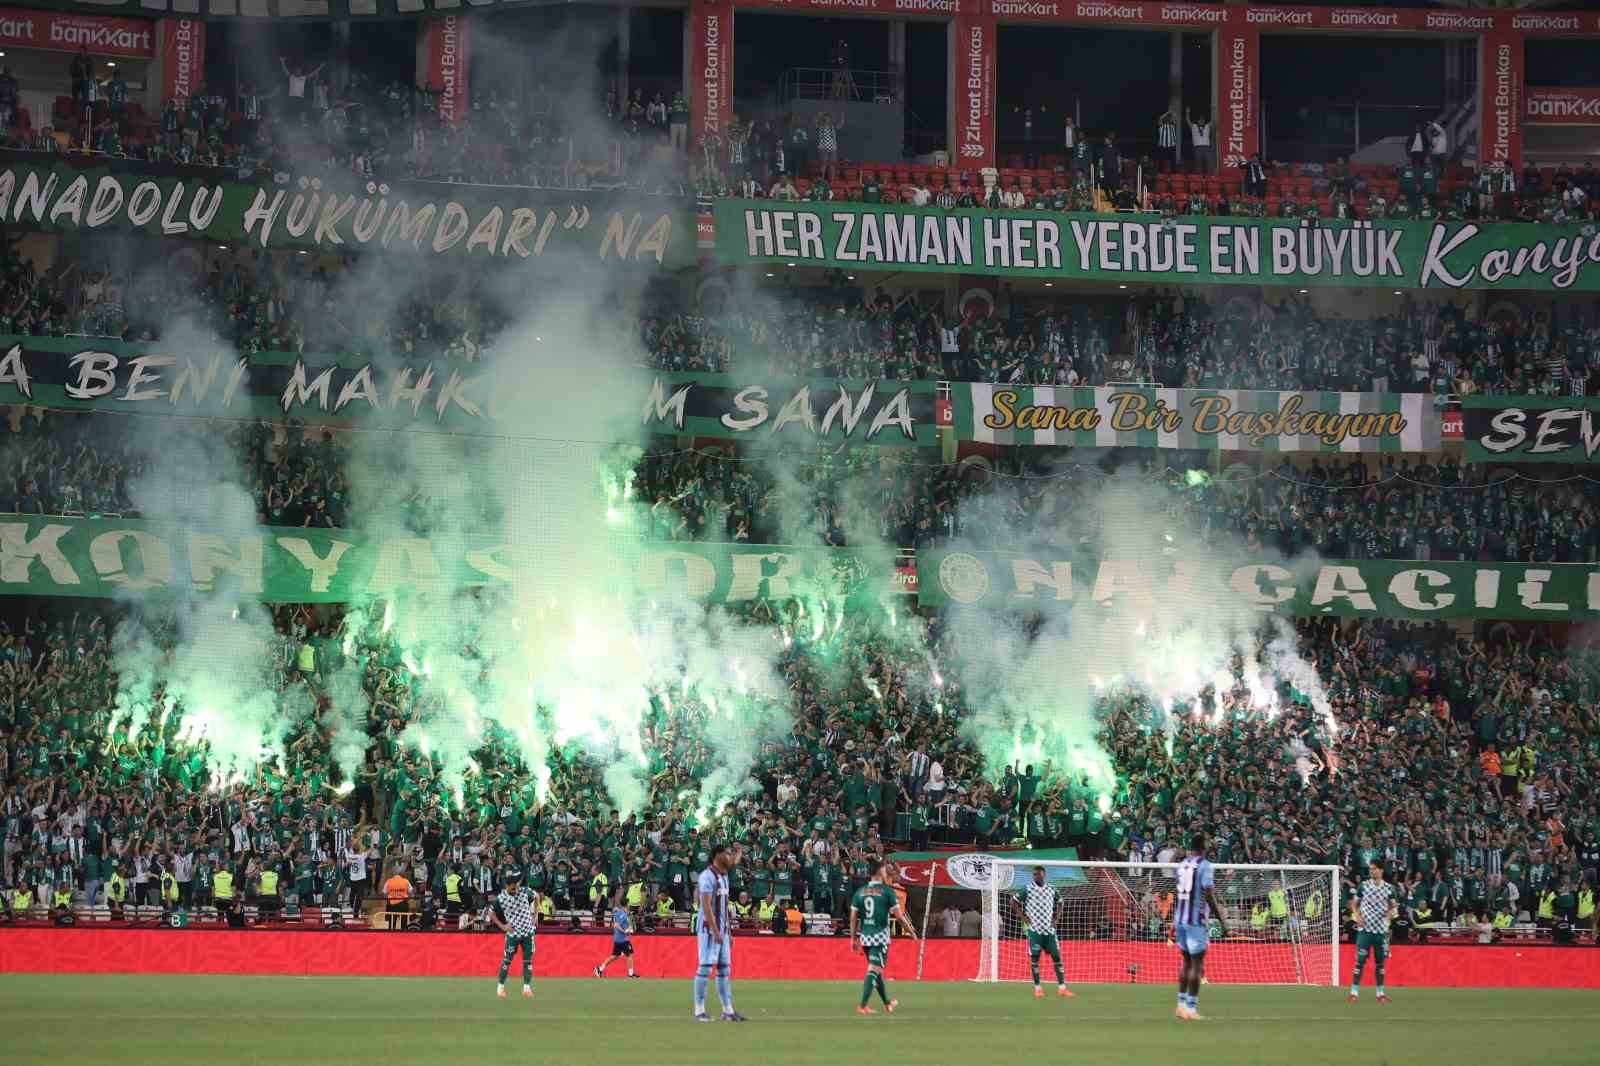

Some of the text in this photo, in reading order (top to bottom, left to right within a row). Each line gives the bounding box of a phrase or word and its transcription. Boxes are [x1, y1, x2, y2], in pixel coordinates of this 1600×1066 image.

[175, 44, 191, 97] Ziraat
[966, 26, 984, 142] Ziraat Bankası
[1228, 37, 1246, 153] Ziraat Bankası
[704, 82, 719, 133] Ziraat
[1494, 44, 1512, 162] Ziraat Bankası
[744, 208, 826, 258] HER
[833, 212, 974, 266] ZAMAN
[984, 217, 1062, 271] HER
[1070, 220, 1200, 275] YERDE
[1209, 224, 1261, 275] EN
[1271, 219, 1404, 278] BÜYÜK
[719, 381, 918, 440] SANA
[983, 389, 1101, 432] Sana
[1106, 390, 1184, 433] Bir
[864, 895, 876, 919] 9
